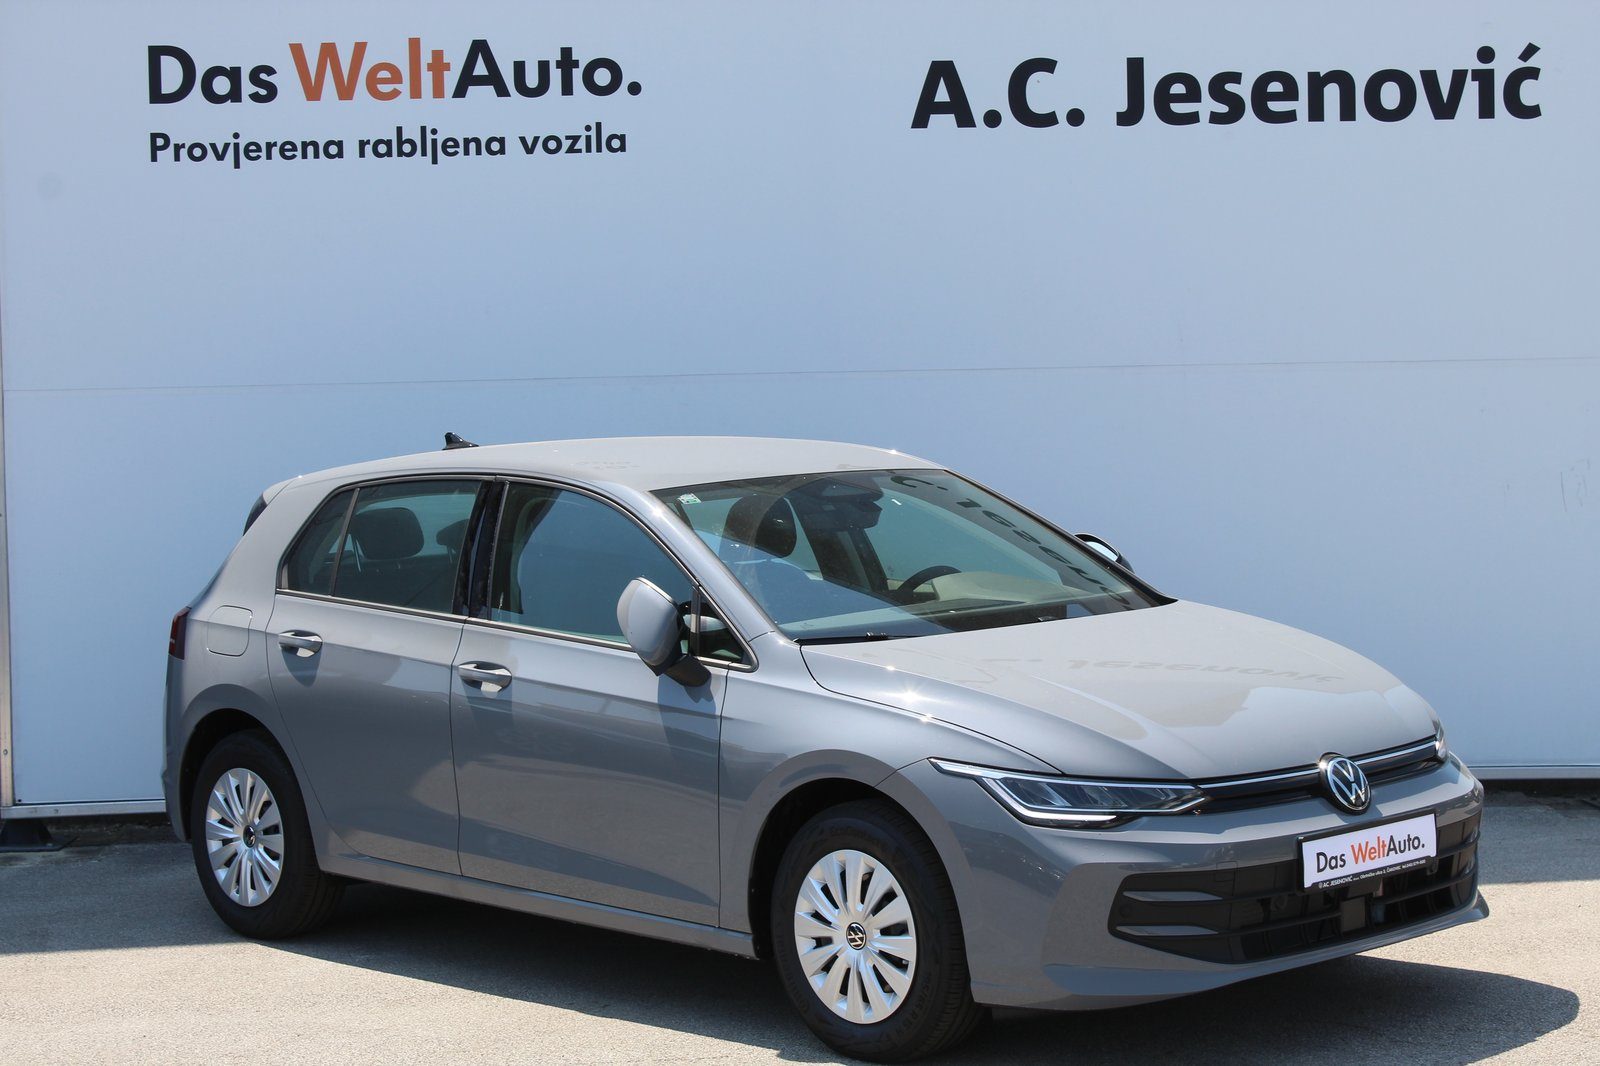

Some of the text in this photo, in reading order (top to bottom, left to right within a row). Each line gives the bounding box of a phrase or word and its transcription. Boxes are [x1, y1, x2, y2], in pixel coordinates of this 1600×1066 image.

[147, 37, 643, 105] Das WeltAuto.
[910, 41, 1542, 130] A.C. Jesenović
[149, 121, 627, 170] Provjerena rabljena vozila
[1316, 851, 1347, 873] Das
[1350, 833, 1426, 865] WeltAuto.
